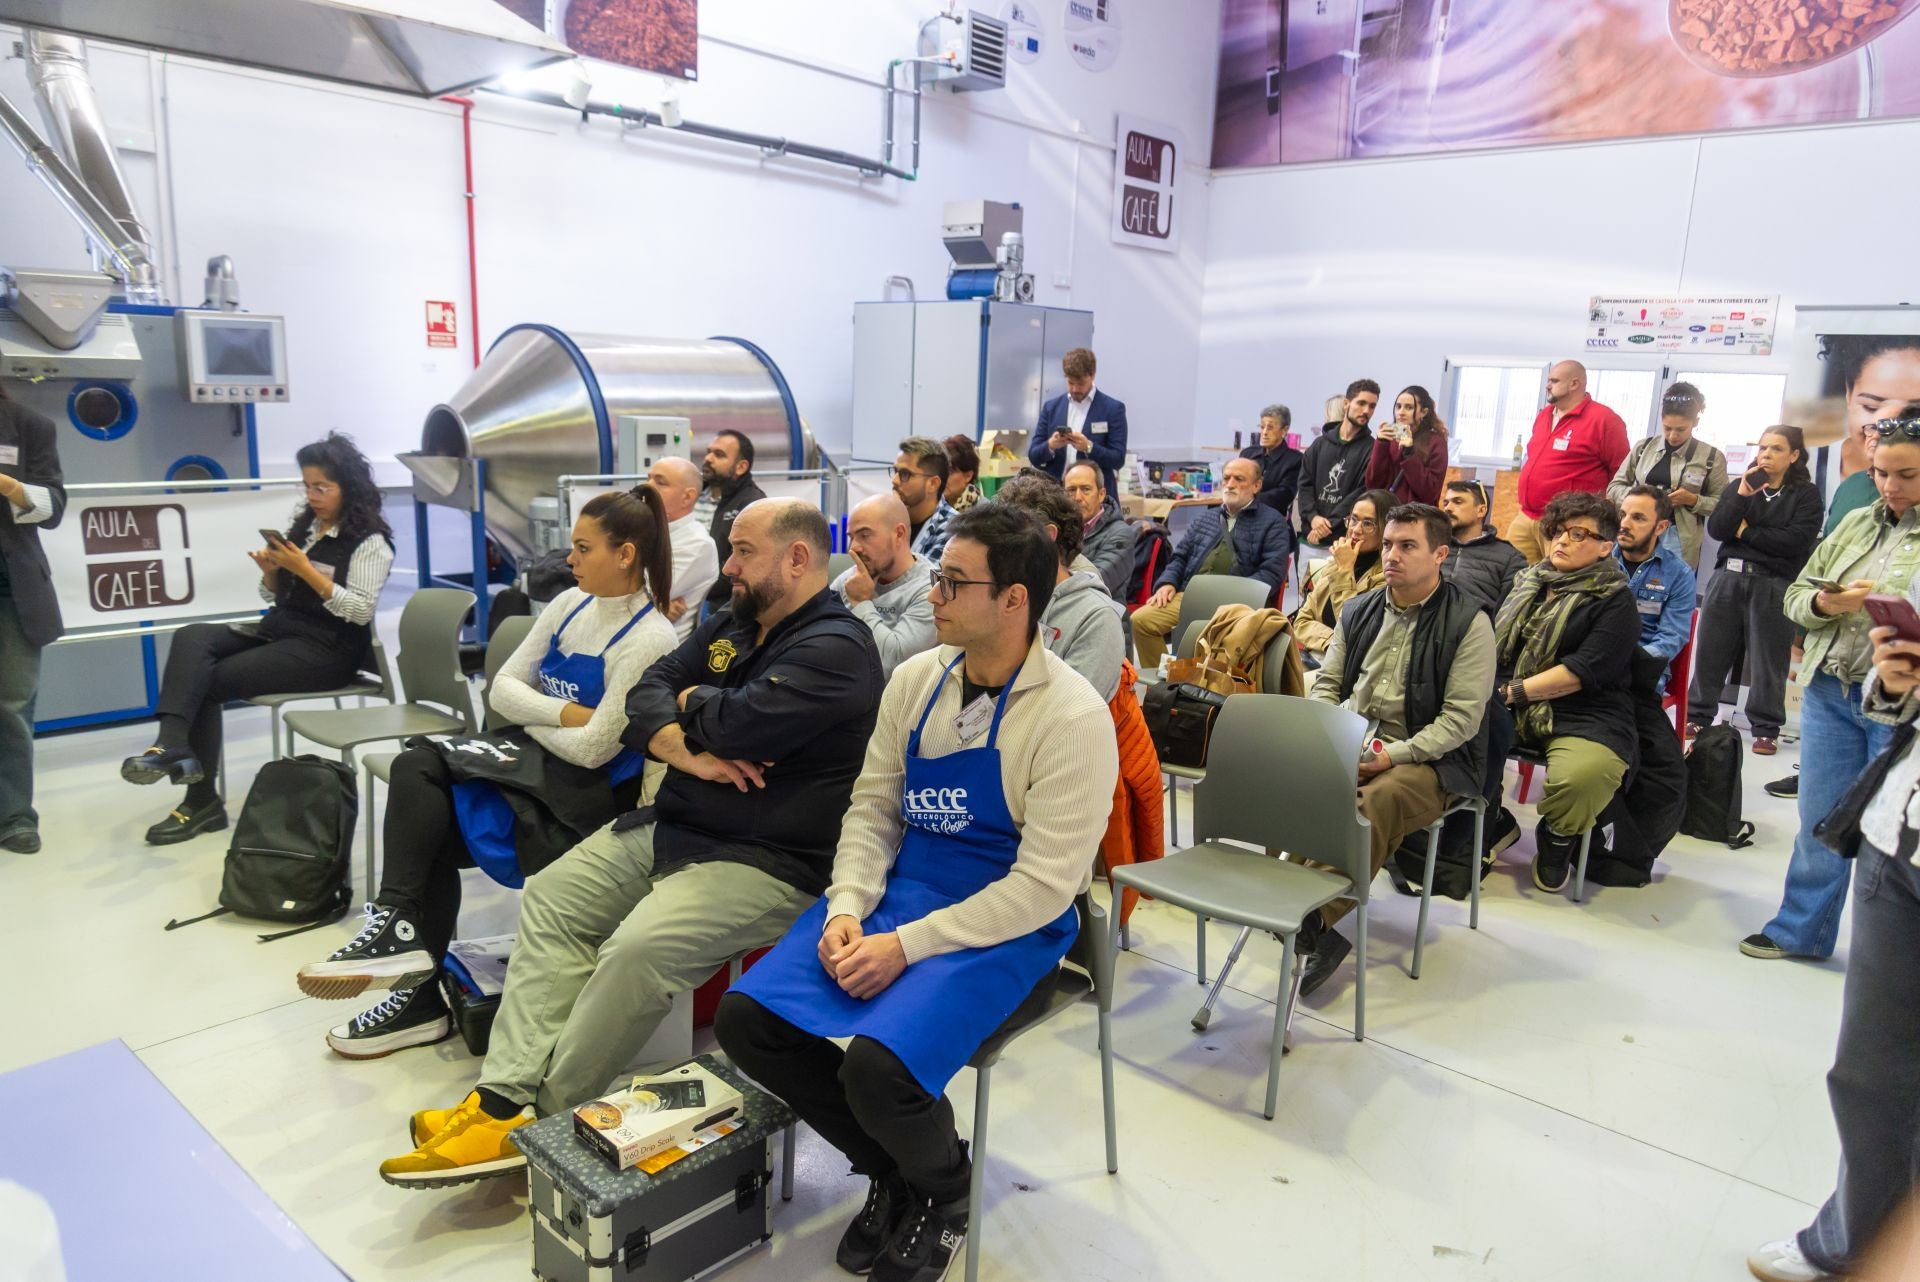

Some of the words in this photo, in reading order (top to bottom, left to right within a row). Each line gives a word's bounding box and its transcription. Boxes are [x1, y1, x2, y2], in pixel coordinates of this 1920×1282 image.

[1127, 135, 1152, 166] AULA
[1124, 193, 1157, 234] CAFÉ
[86, 510, 140, 538] AULA
[94, 561, 161, 608] CAFÉ
[912, 813, 974, 821] TECNOLÓGICO
[624, 1149, 639, 1161] V60
[640, 1145, 656, 1155] Drip
